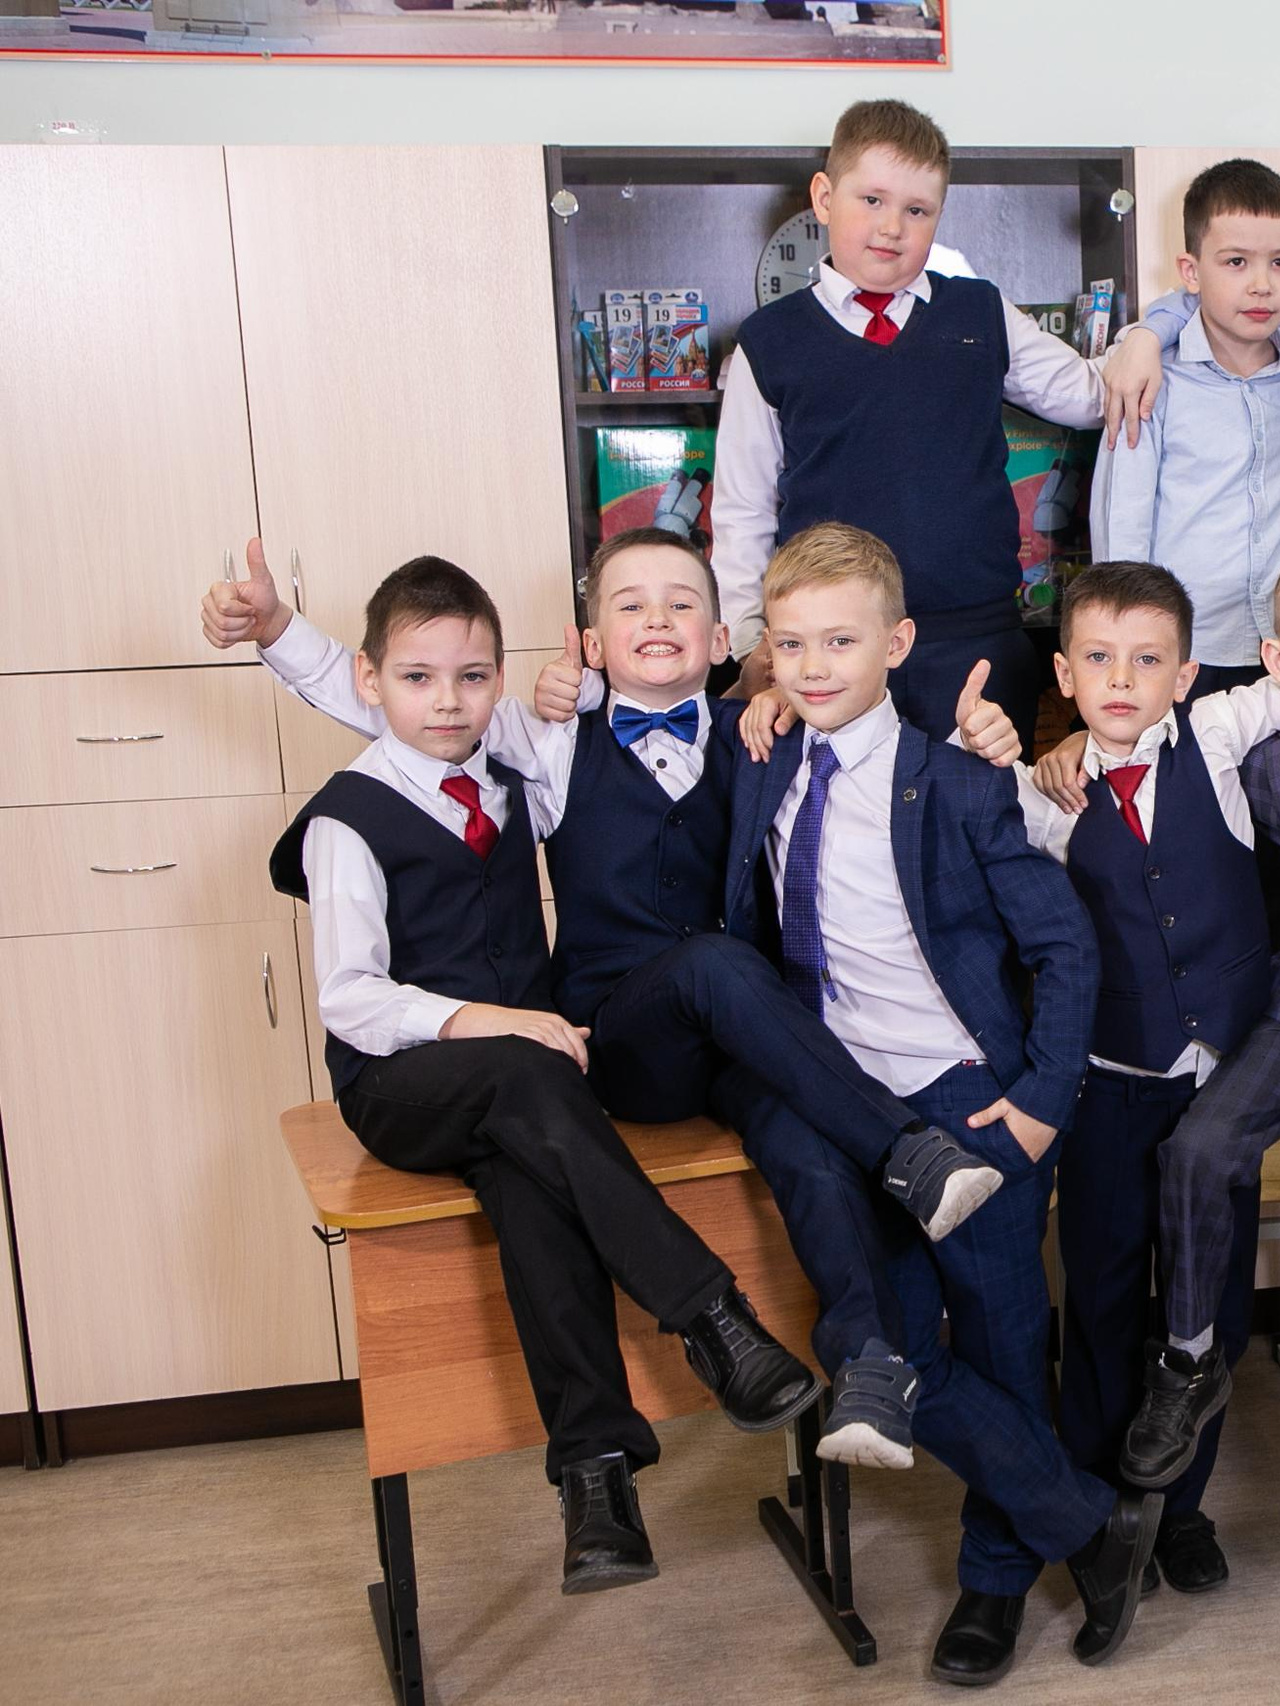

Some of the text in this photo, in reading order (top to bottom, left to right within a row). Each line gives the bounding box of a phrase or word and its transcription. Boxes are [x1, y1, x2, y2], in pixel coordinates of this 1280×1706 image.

[805, 223, 819, 241] 11
[778, 243, 796, 262] 10
[770, 276, 781, 294] 9
[613, 307, 632, 323] 19
[654, 308, 671, 322] 19
[659, 379, 691, 388] РОССИЯ
